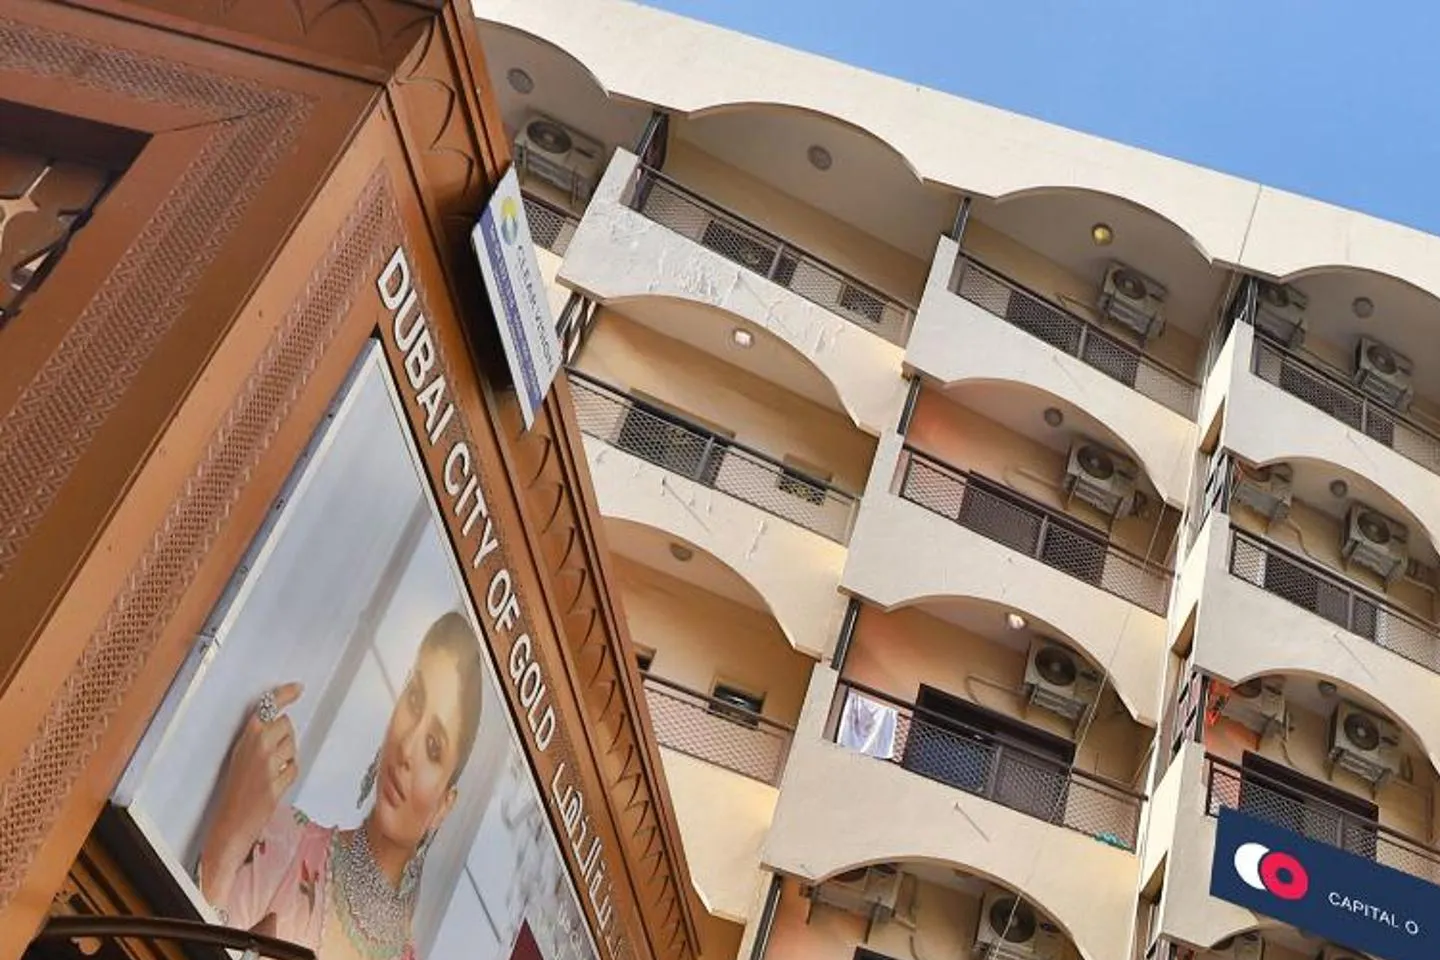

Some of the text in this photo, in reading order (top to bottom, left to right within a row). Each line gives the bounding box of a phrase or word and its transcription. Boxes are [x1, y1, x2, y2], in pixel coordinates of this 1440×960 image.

[377, 245, 556, 752] DUBAI CITY OF GOLD
[1327, 891, 1419, 936] CAPITAL O
